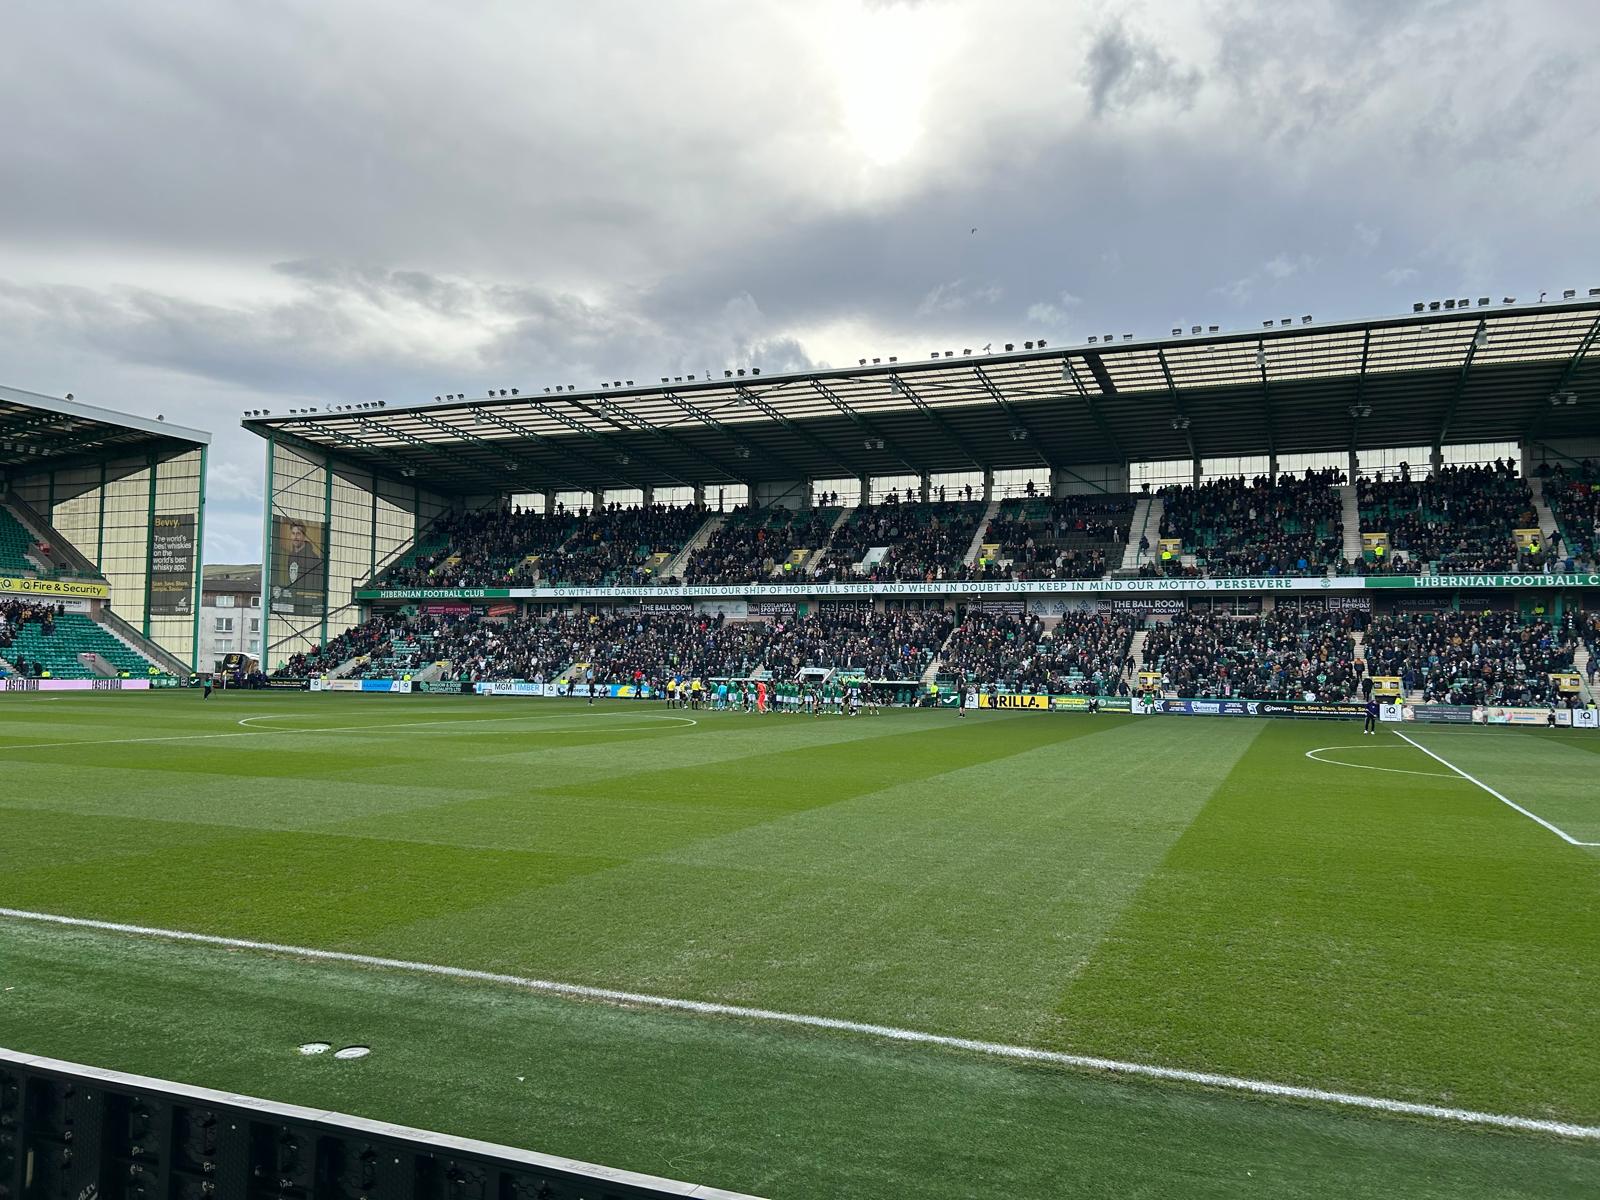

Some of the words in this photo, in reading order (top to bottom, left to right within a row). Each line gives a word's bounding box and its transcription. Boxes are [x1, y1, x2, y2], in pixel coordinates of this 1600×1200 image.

[155, 518, 180, 528] Bevvy.
[963, 584, 1000, 592] DOUBT
[1005, 583, 1034, 591] JUST
[1038, 583, 1067, 591] KEEP
[1090, 582, 1122, 590] MIND
[1127, 581, 1154, 590] OUR
[1216, 580, 1292, 588] PERSEVERE
[1414, 576, 1496, 587] HIBERNIAN
[1503, 576, 1583, 586] FOOTBALL
[33, 582, 52, 590] Fire
[63, 584, 102, 595] Security
